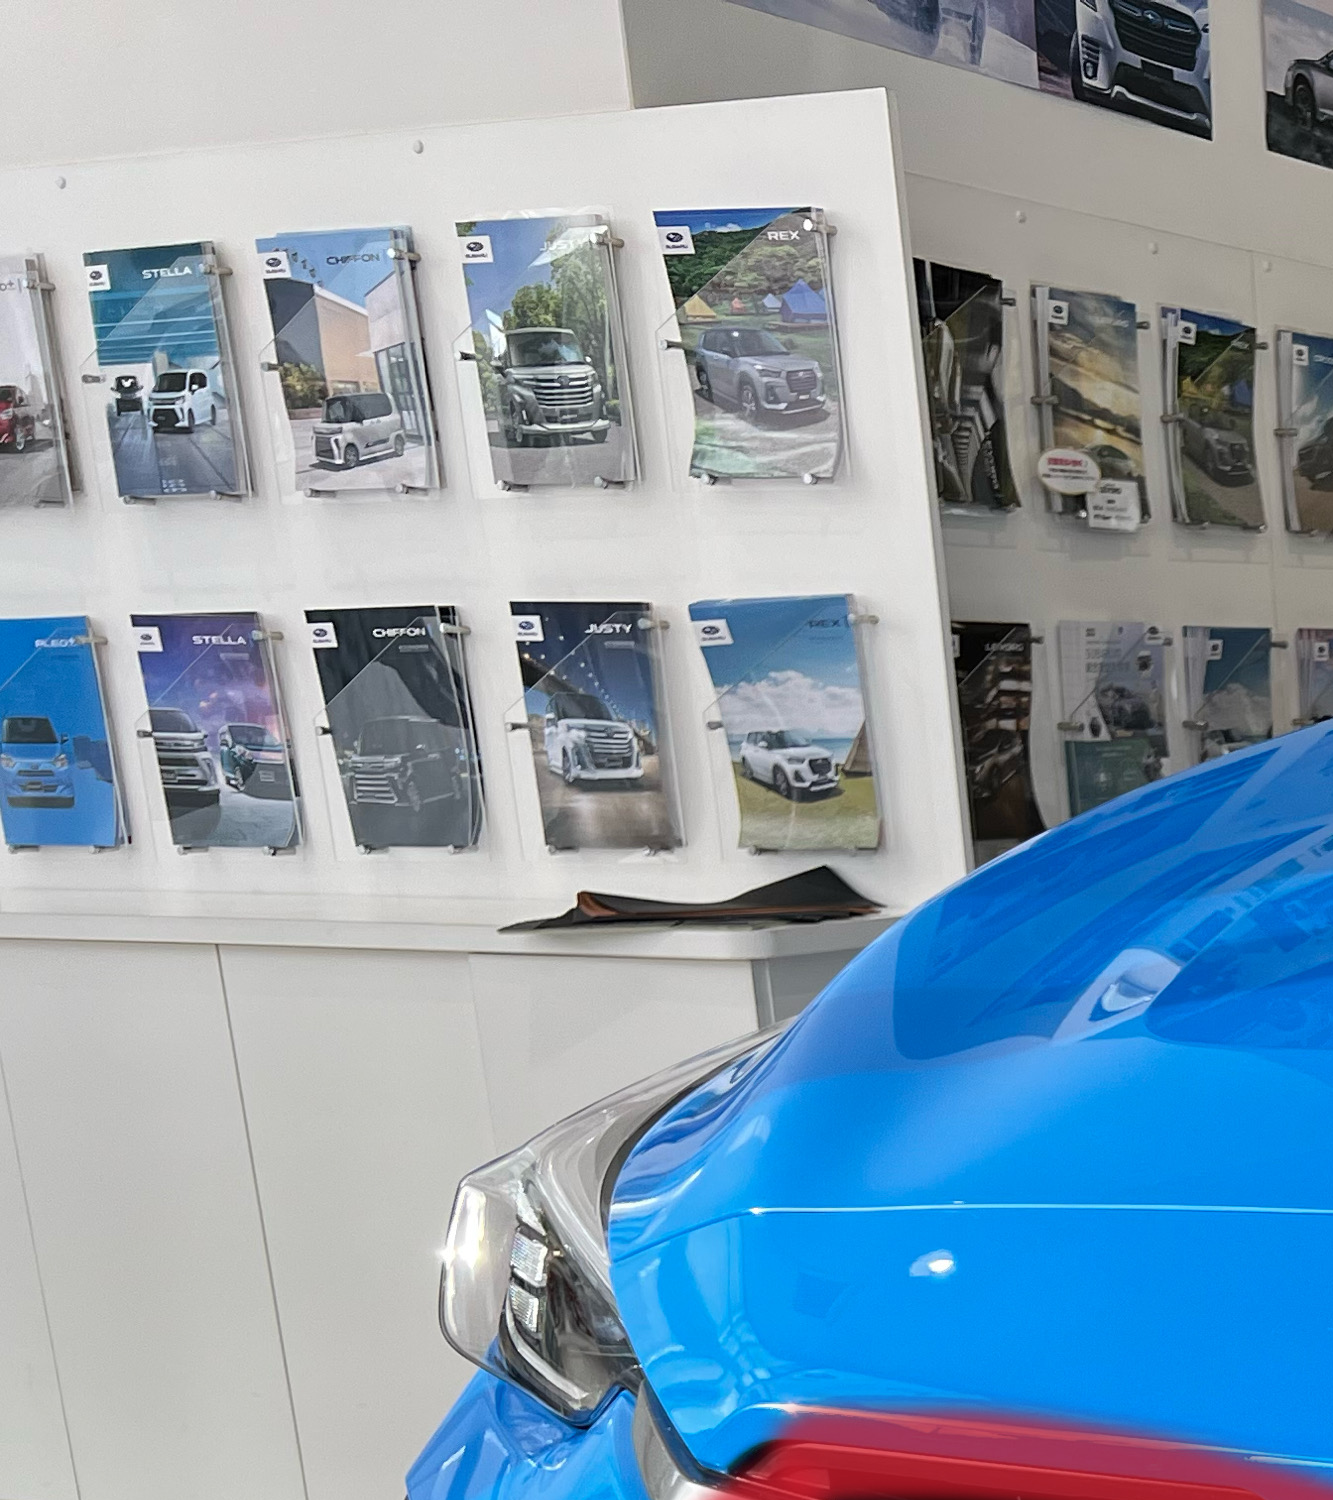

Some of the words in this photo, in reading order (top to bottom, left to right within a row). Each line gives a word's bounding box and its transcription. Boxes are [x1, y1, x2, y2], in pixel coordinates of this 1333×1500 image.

[767, 230, 800, 241] REX
[326, 253, 380, 266] CHIFFON
[142, 266, 192, 280] STELLA
[372, 627, 426, 639] CHIFFON
[584, 623, 633, 635] JUSTY
[192, 635, 247, 646] STELLA
